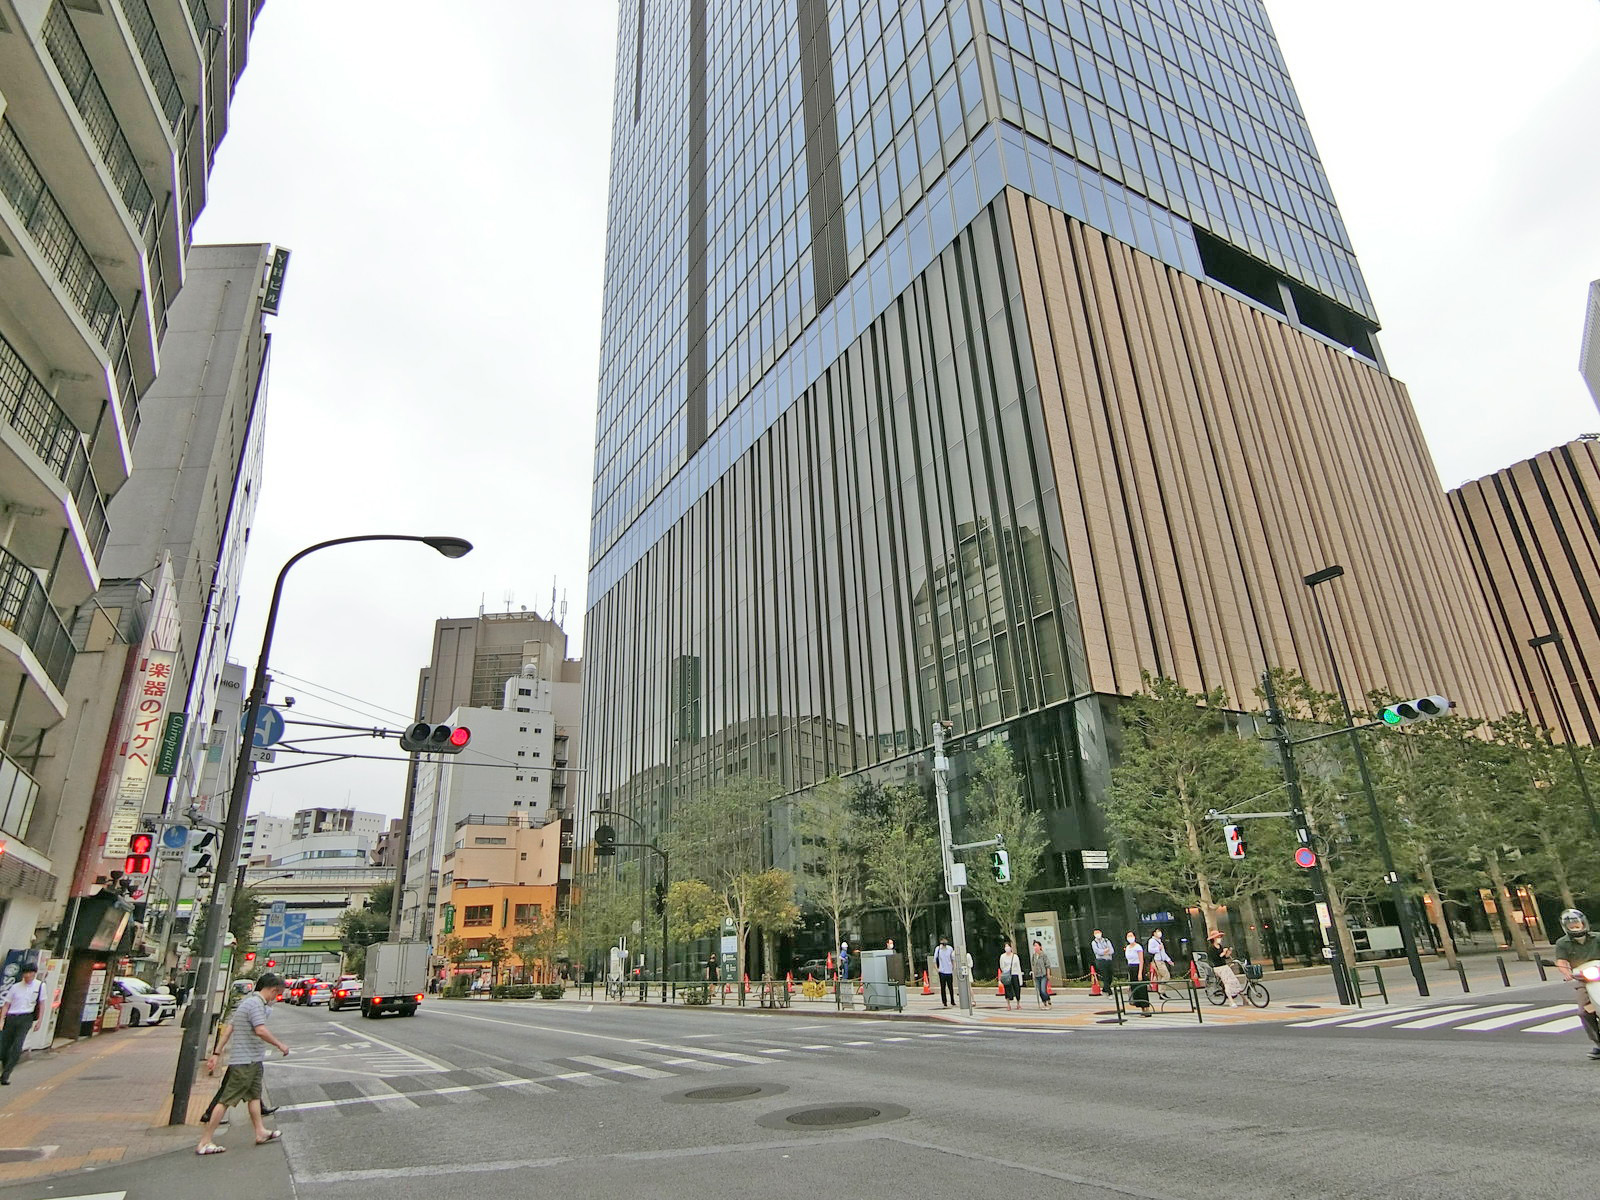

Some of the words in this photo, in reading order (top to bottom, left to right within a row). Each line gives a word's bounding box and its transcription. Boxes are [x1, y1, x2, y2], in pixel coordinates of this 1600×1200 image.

[128, 663, 171, 766] 楽器のイケベ
[162, 715, 184, 772] Chiropractic
